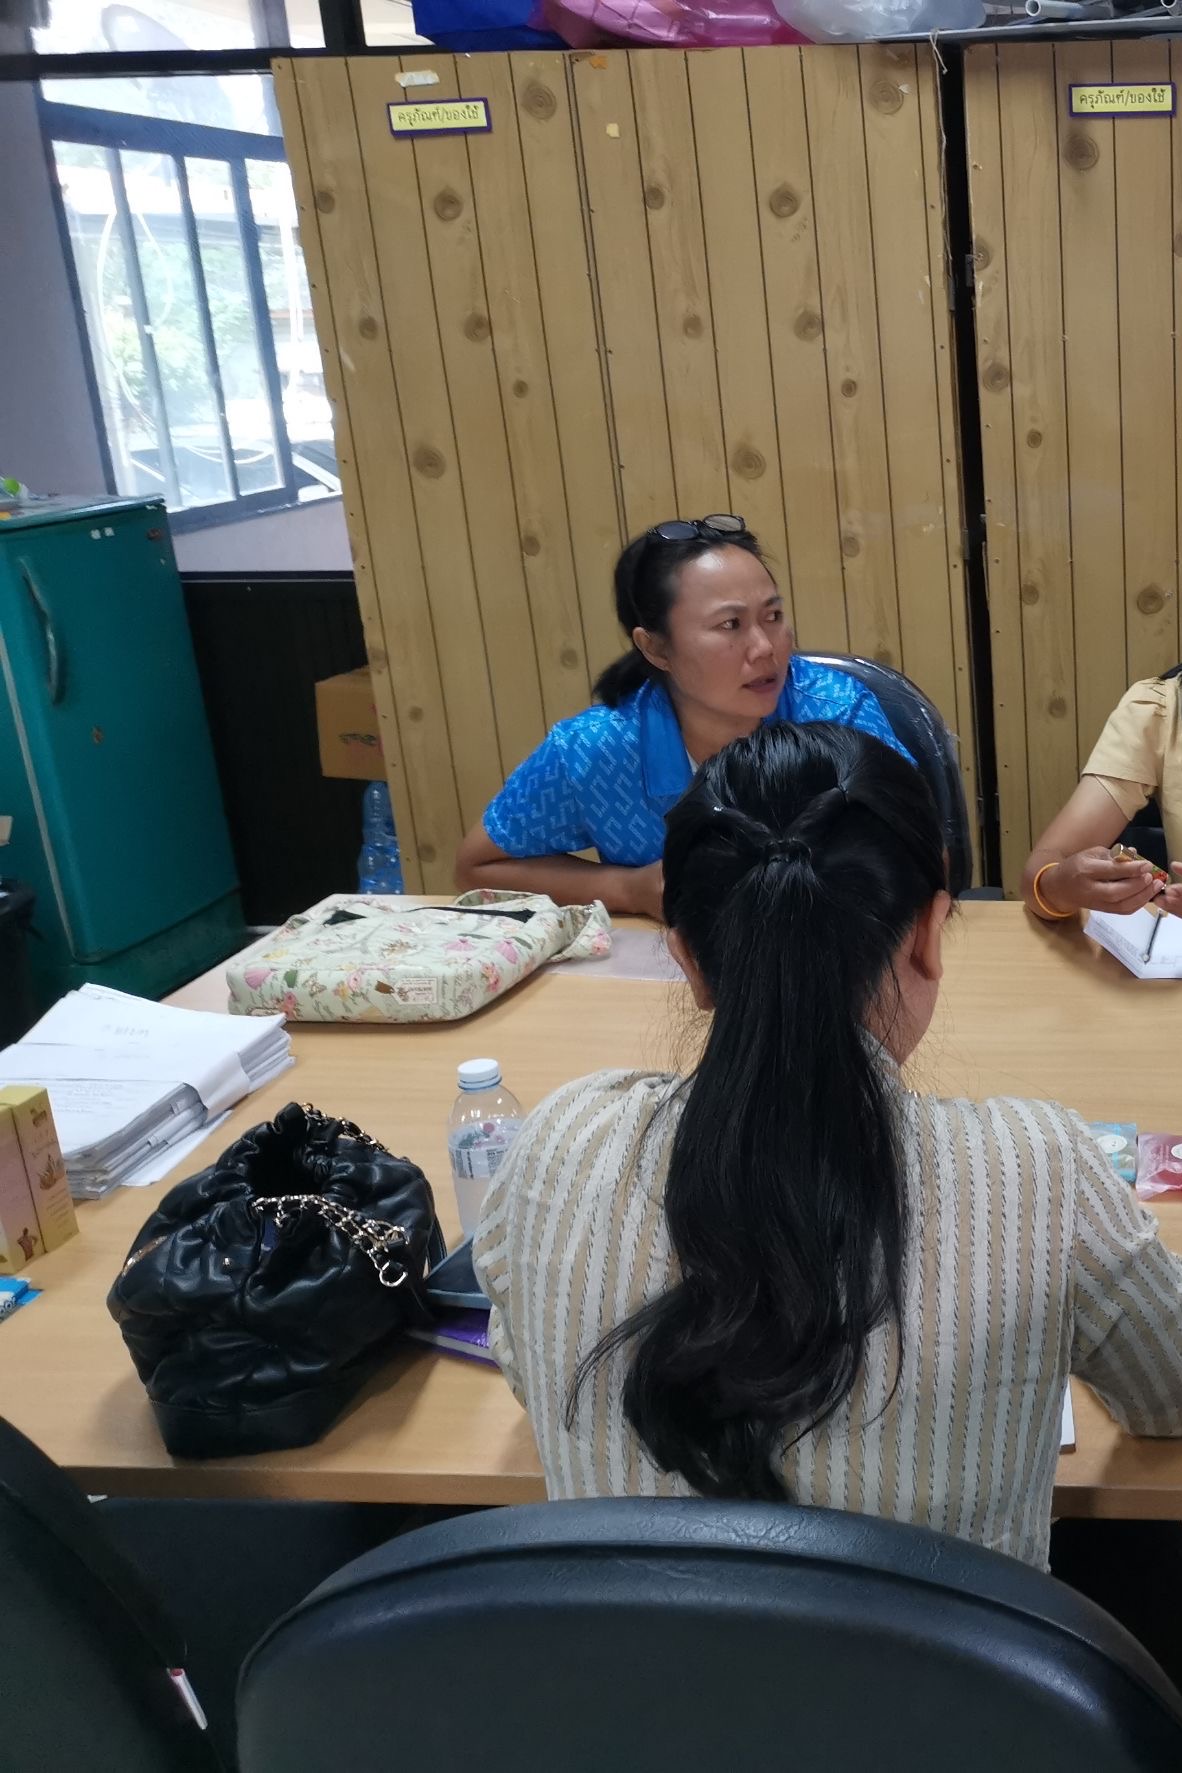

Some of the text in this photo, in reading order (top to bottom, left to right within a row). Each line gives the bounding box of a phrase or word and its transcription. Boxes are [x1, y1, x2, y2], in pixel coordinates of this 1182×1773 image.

[1079, 87, 1166, 109] ครุภัณฑ์/ของใช้
